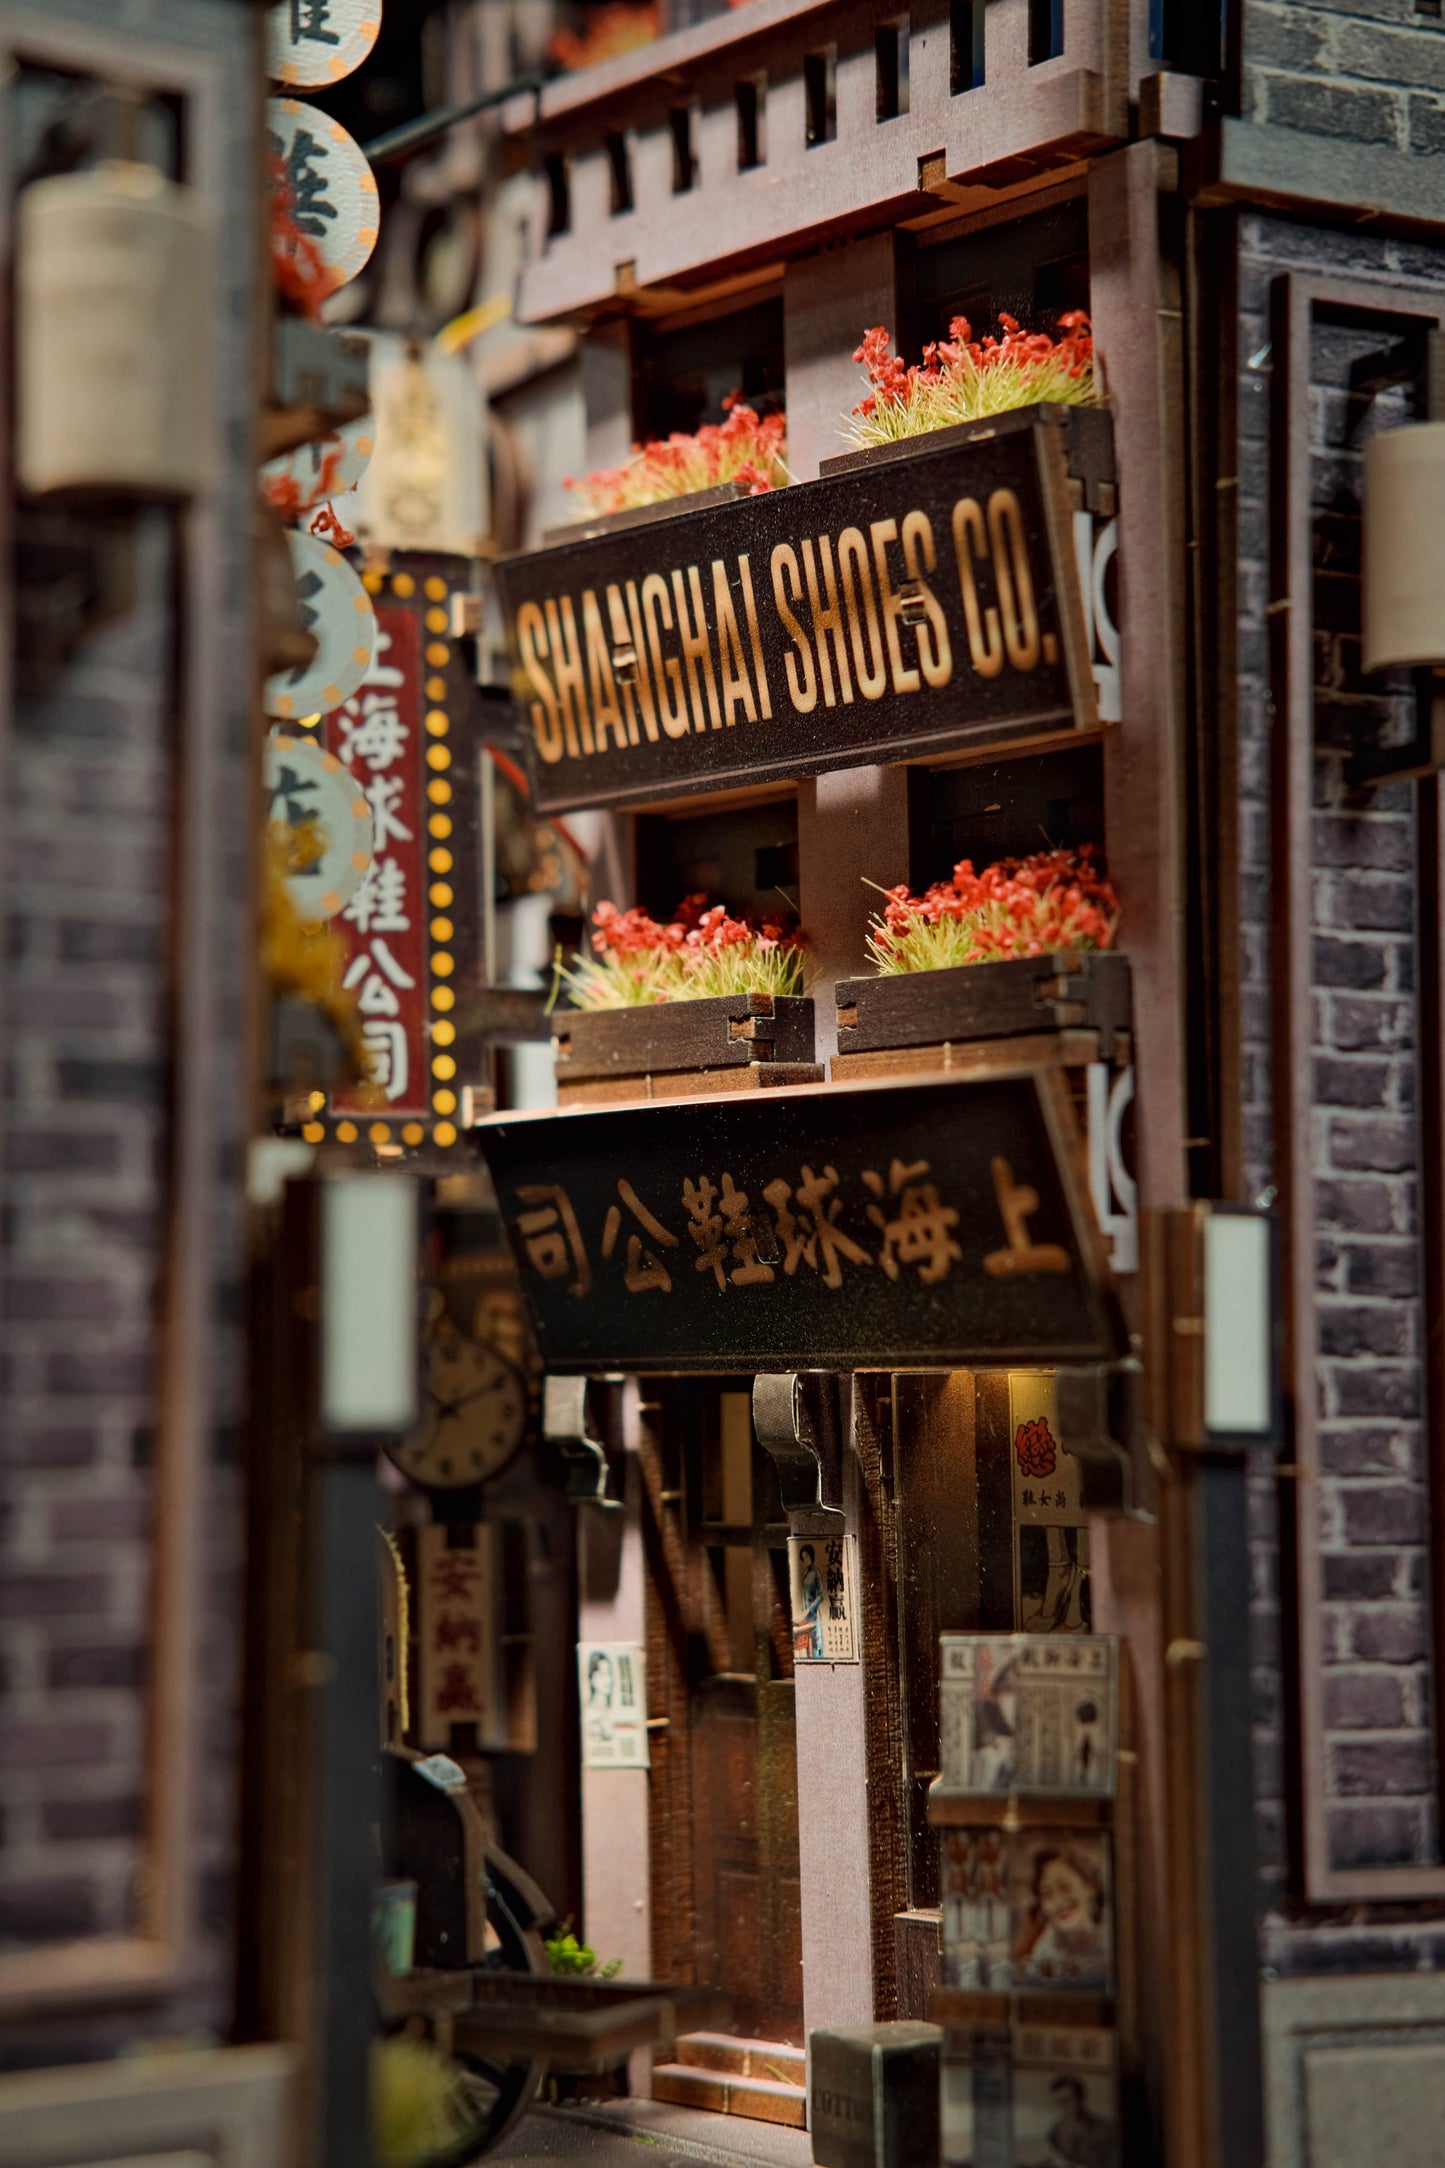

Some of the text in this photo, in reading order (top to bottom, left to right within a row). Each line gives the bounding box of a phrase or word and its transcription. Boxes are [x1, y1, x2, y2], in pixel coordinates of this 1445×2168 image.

[517, 554, 773, 764] SHANGHAI
[770, 510, 953, 714] SHOES
[952, 489, 1059, 679] CO.
